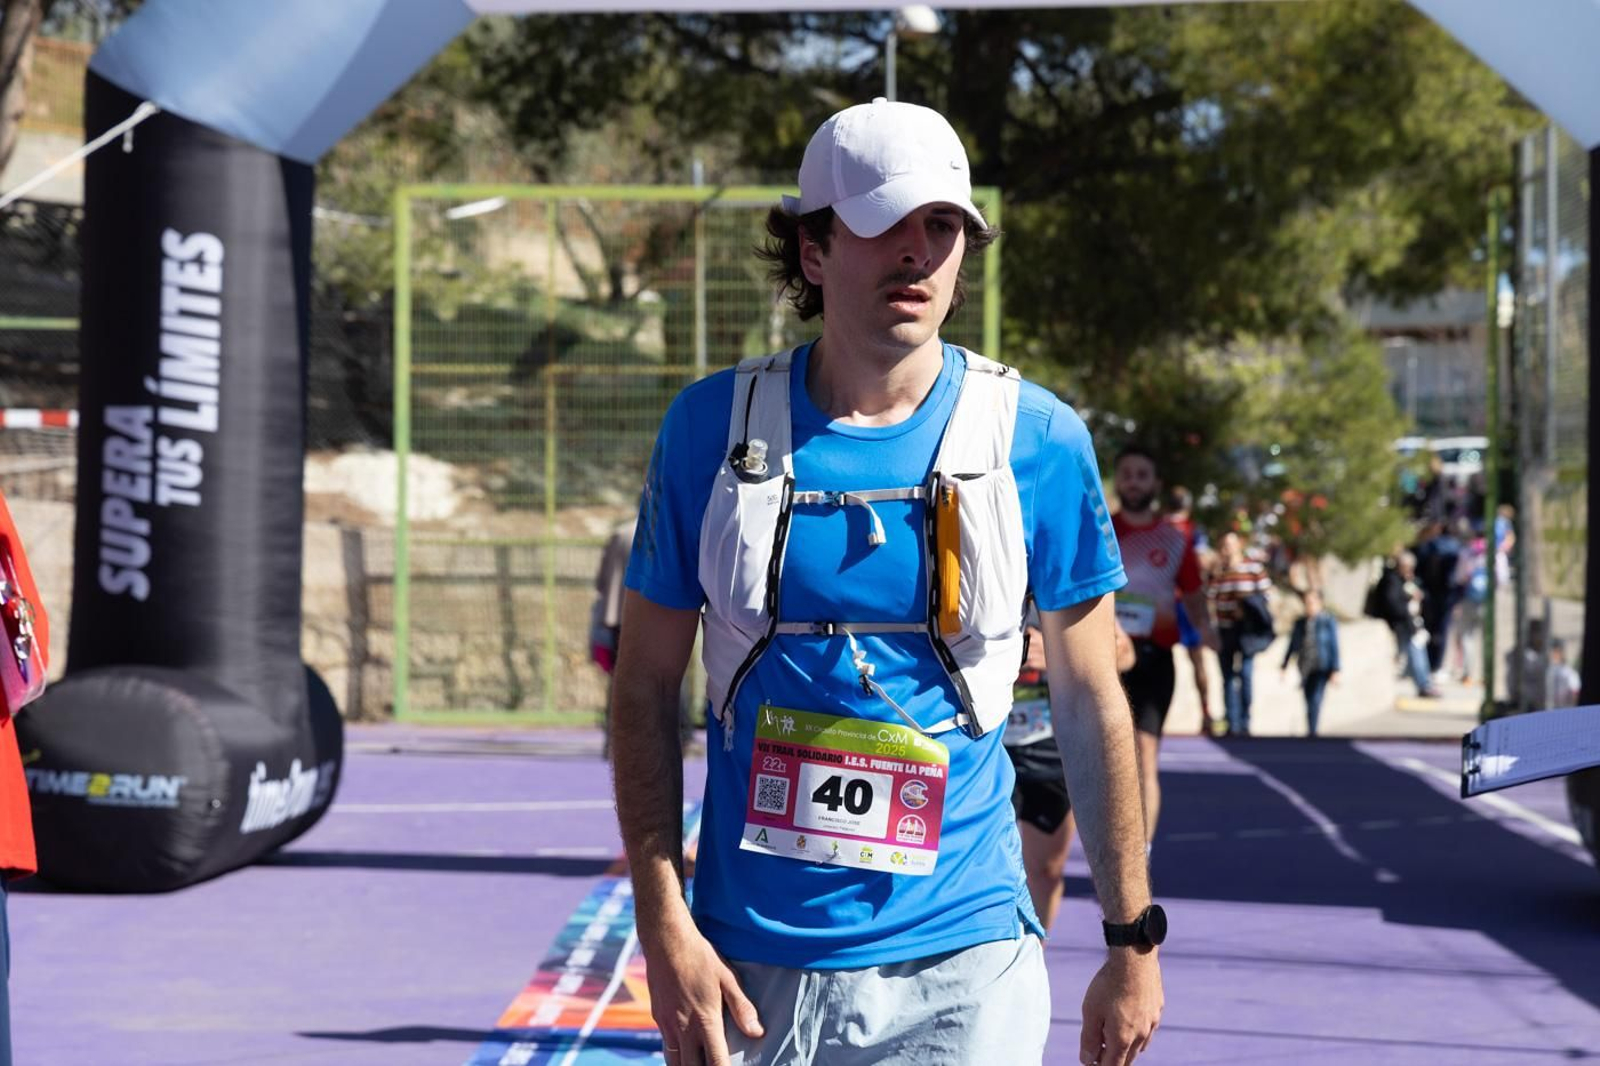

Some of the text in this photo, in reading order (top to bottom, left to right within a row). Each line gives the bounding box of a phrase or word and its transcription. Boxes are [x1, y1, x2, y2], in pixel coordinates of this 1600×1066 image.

[143, 227, 224, 507] TUS LÍMITES
[99, 404, 154, 601] SUPERA
[875, 743, 906, 757] 2025
[877, 729, 908, 745] CxM
[772, 744, 795, 757] TRAIL
[797, 749, 843, 764] SOLIDARIO
[844, 755, 868, 768] I.E.S.
[870, 759, 904, 773] FUENTE
[905, 763, 917, 775] LA
[918, 764, 943, 778] PEÑA
[811, 775, 874, 816] 40
